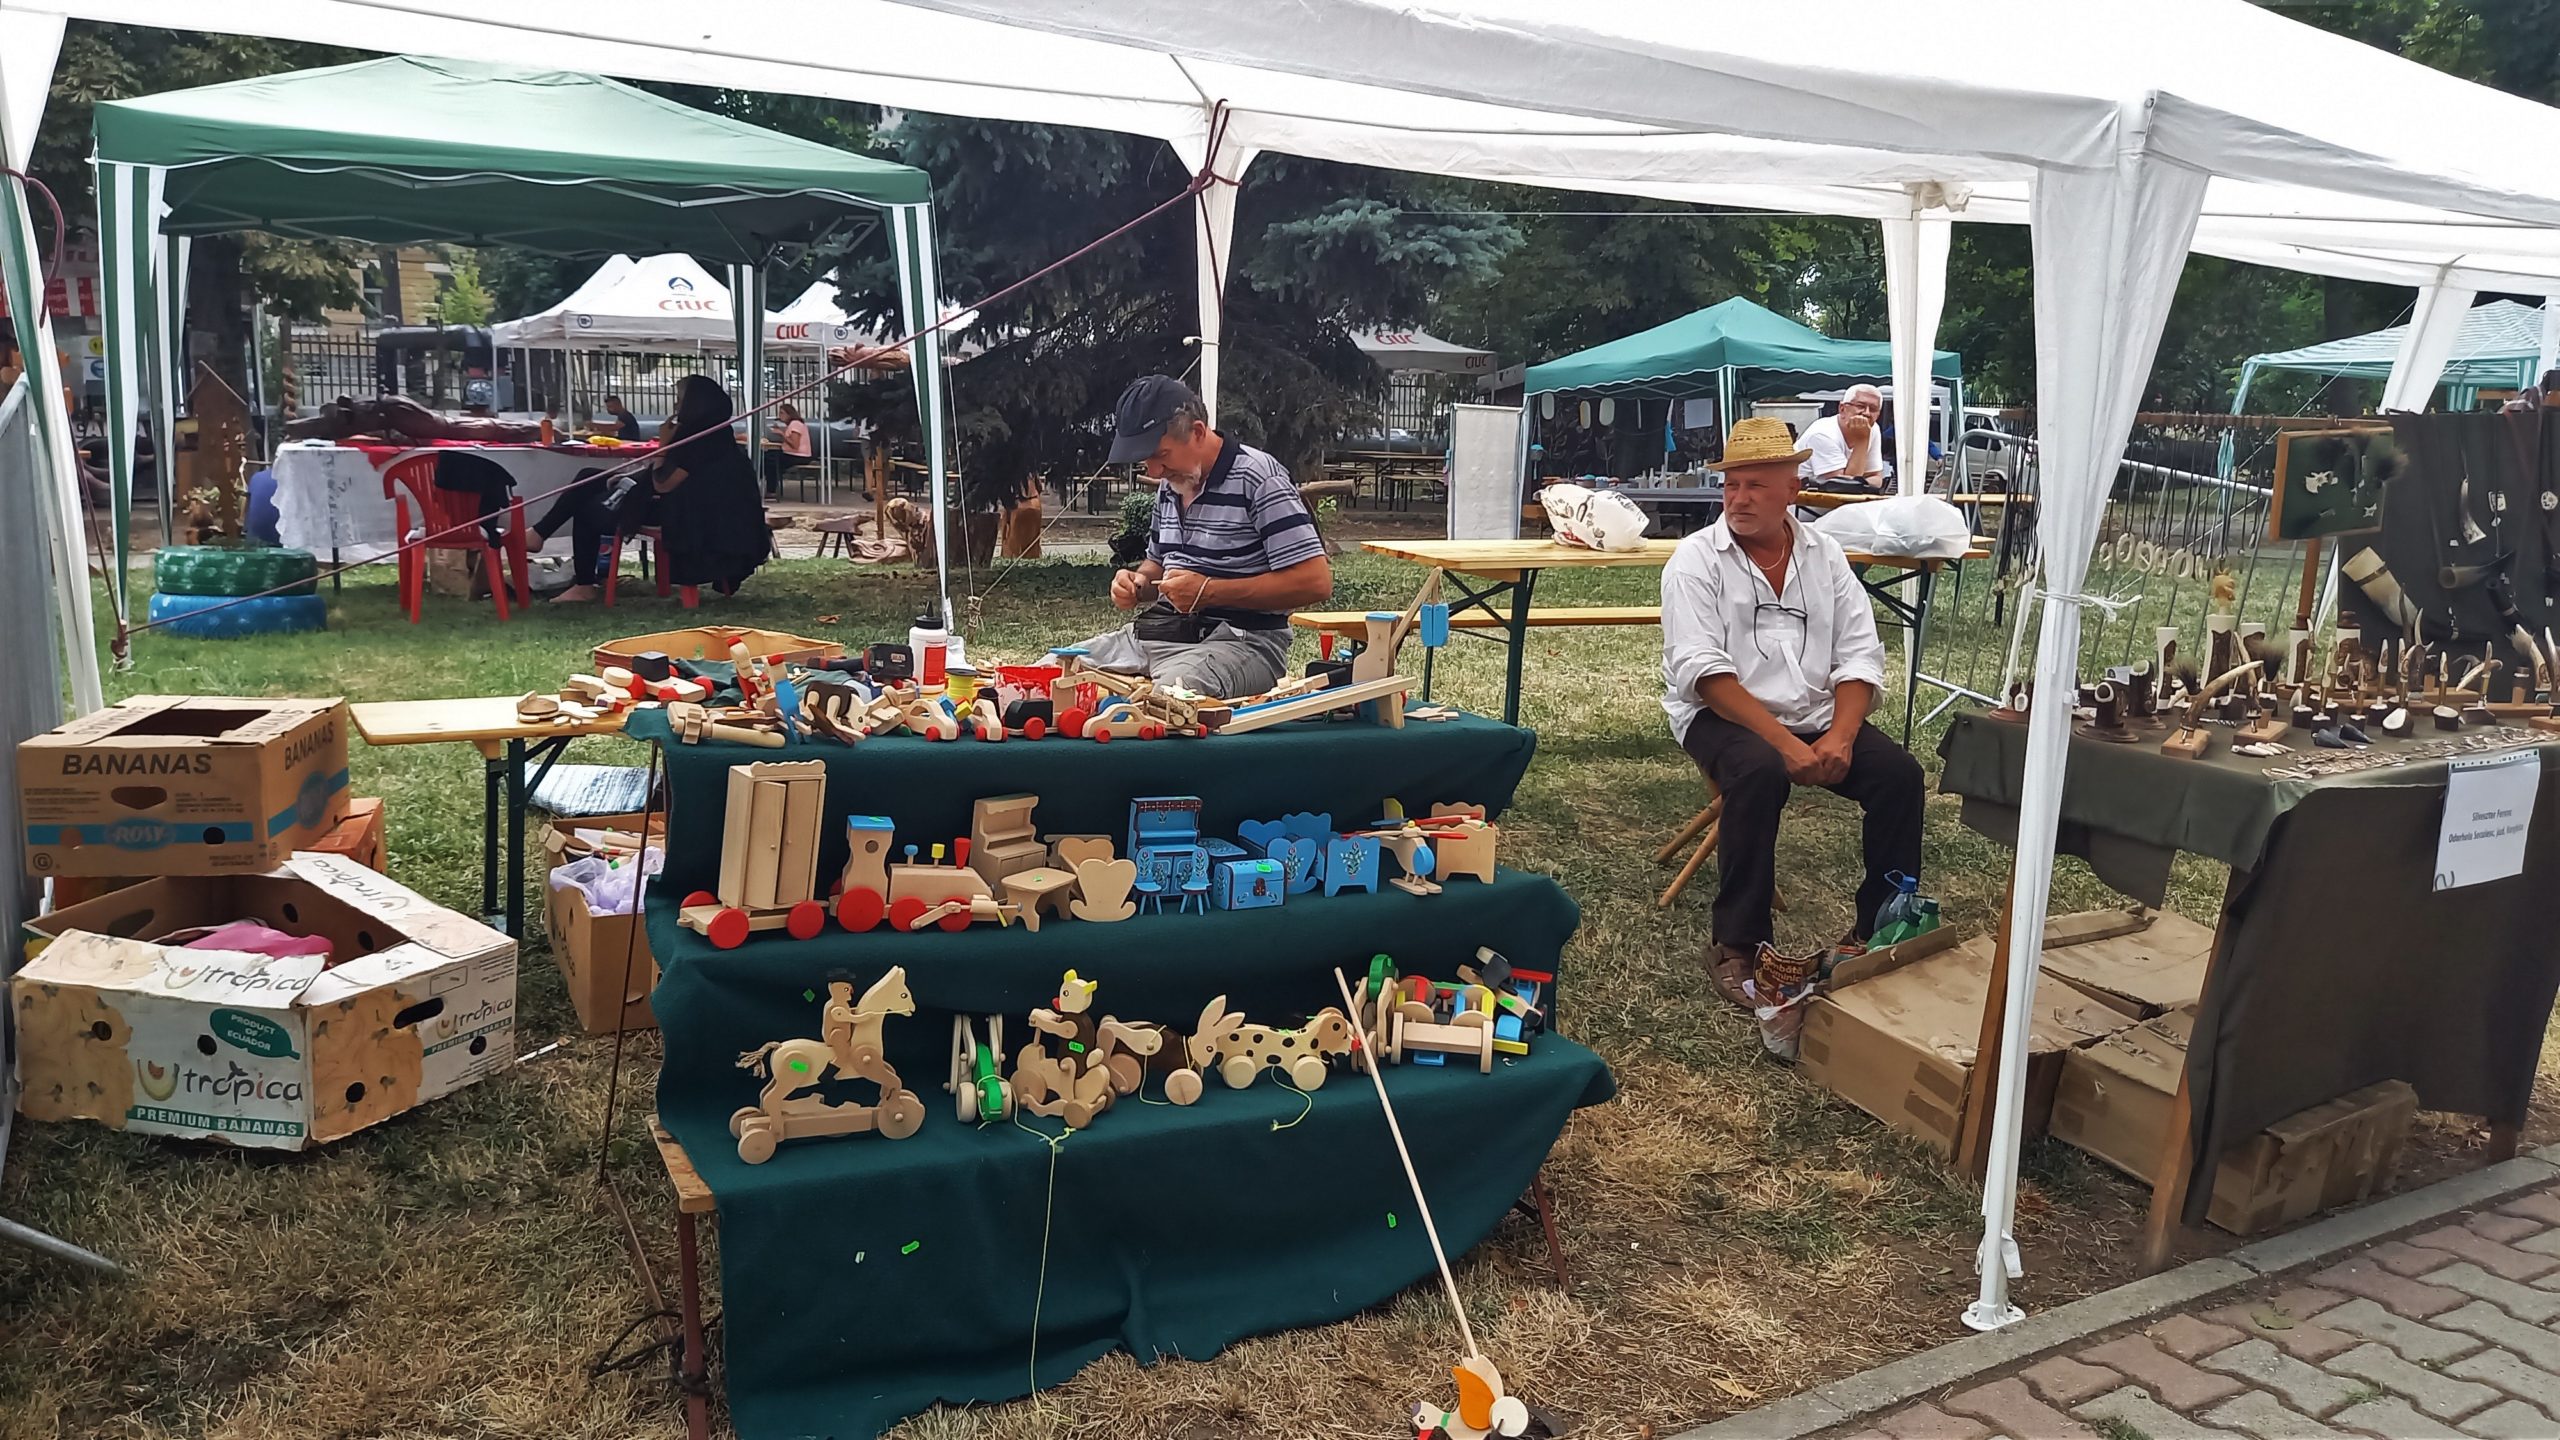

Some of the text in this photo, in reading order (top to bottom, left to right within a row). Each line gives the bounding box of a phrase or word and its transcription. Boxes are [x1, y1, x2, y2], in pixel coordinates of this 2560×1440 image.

[284, 720, 334, 771] BANANAS
[62, 753, 212, 775] BANANAS
[231, 1014, 275, 1036] PRODUCT
[245, 1028, 258, 1037] OF
[227, 1030, 271, 1050] ECUADOR
[137, 1108, 298, 1135] PREMIUM BANANAS
